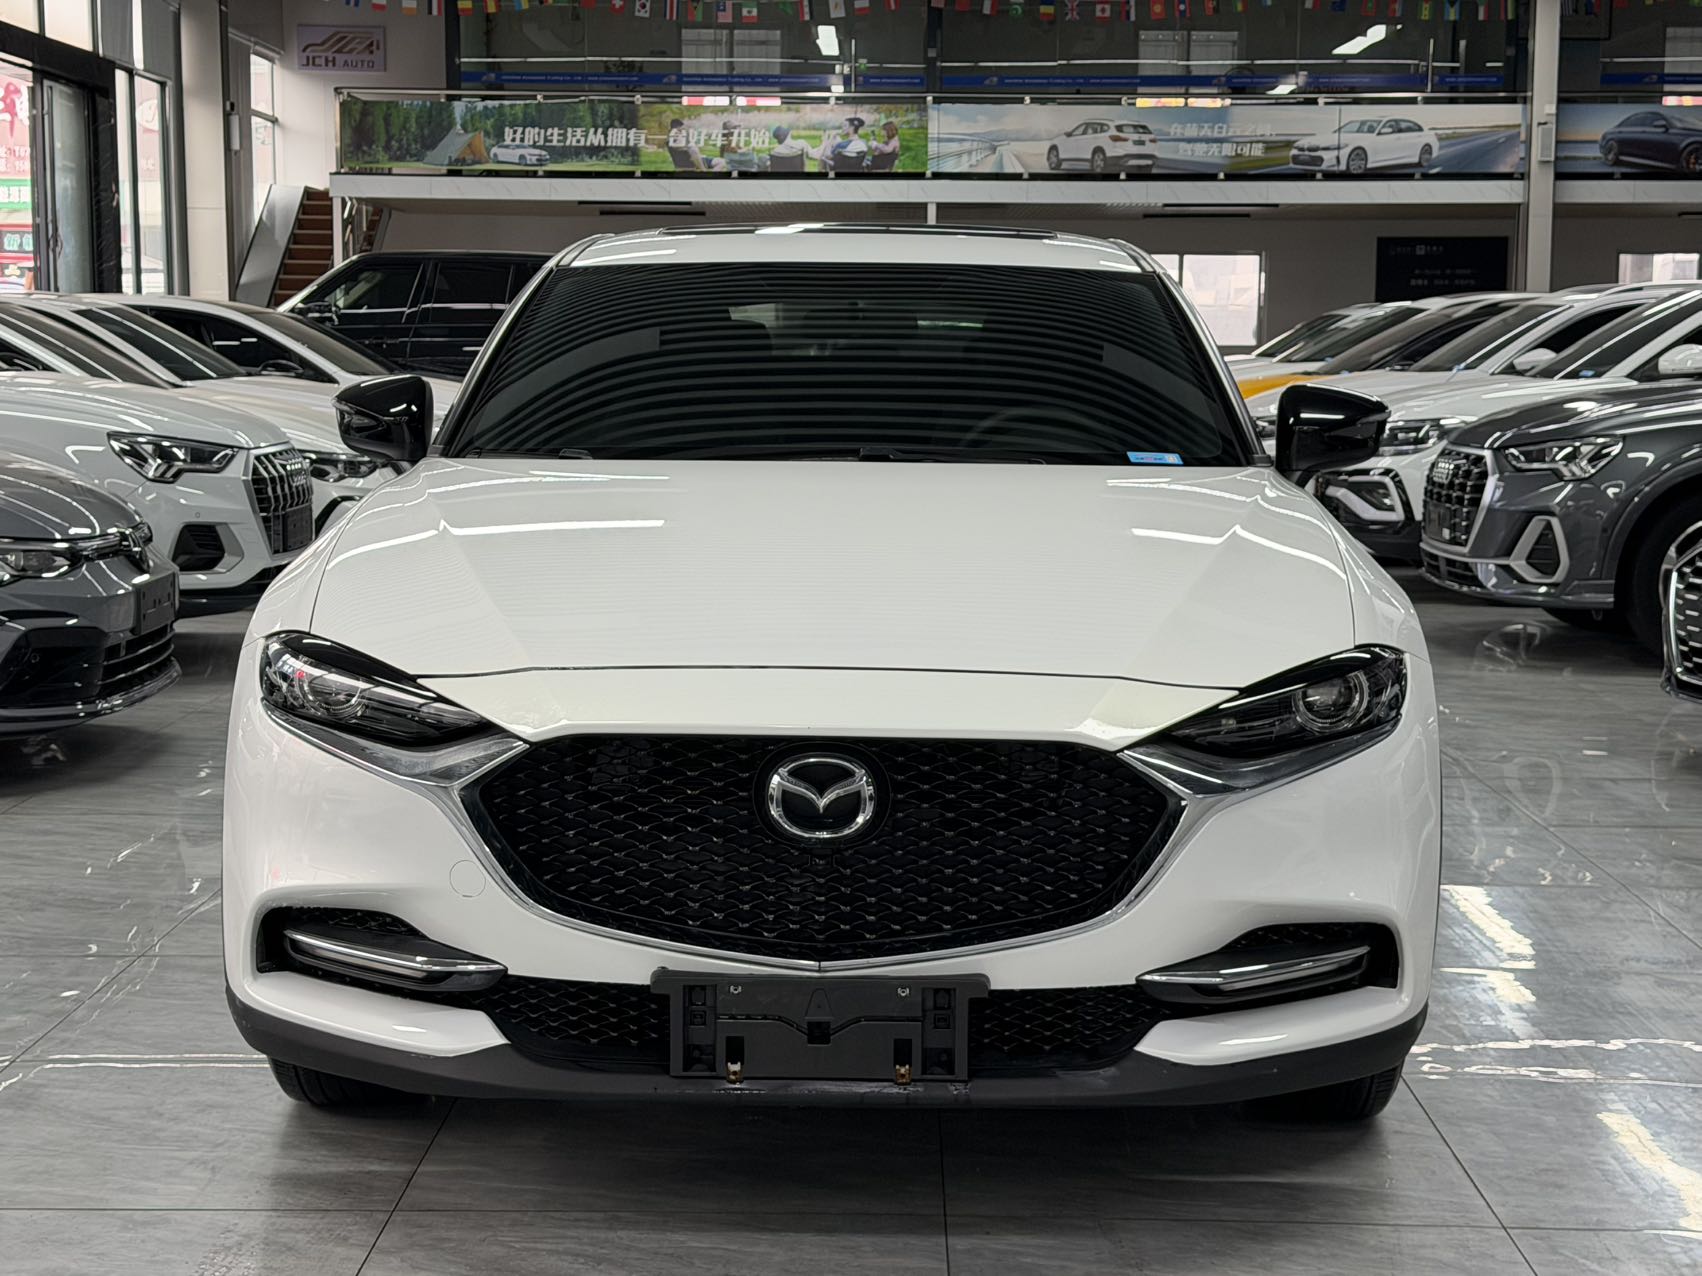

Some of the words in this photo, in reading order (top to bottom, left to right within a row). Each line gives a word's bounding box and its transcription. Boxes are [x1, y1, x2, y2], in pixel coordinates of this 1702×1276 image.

[301, 56, 336, 67] JCH
[343, 60, 375, 69] AUTO
[504, 126, 770, 148] 好的生活从拥有一台好车开始
